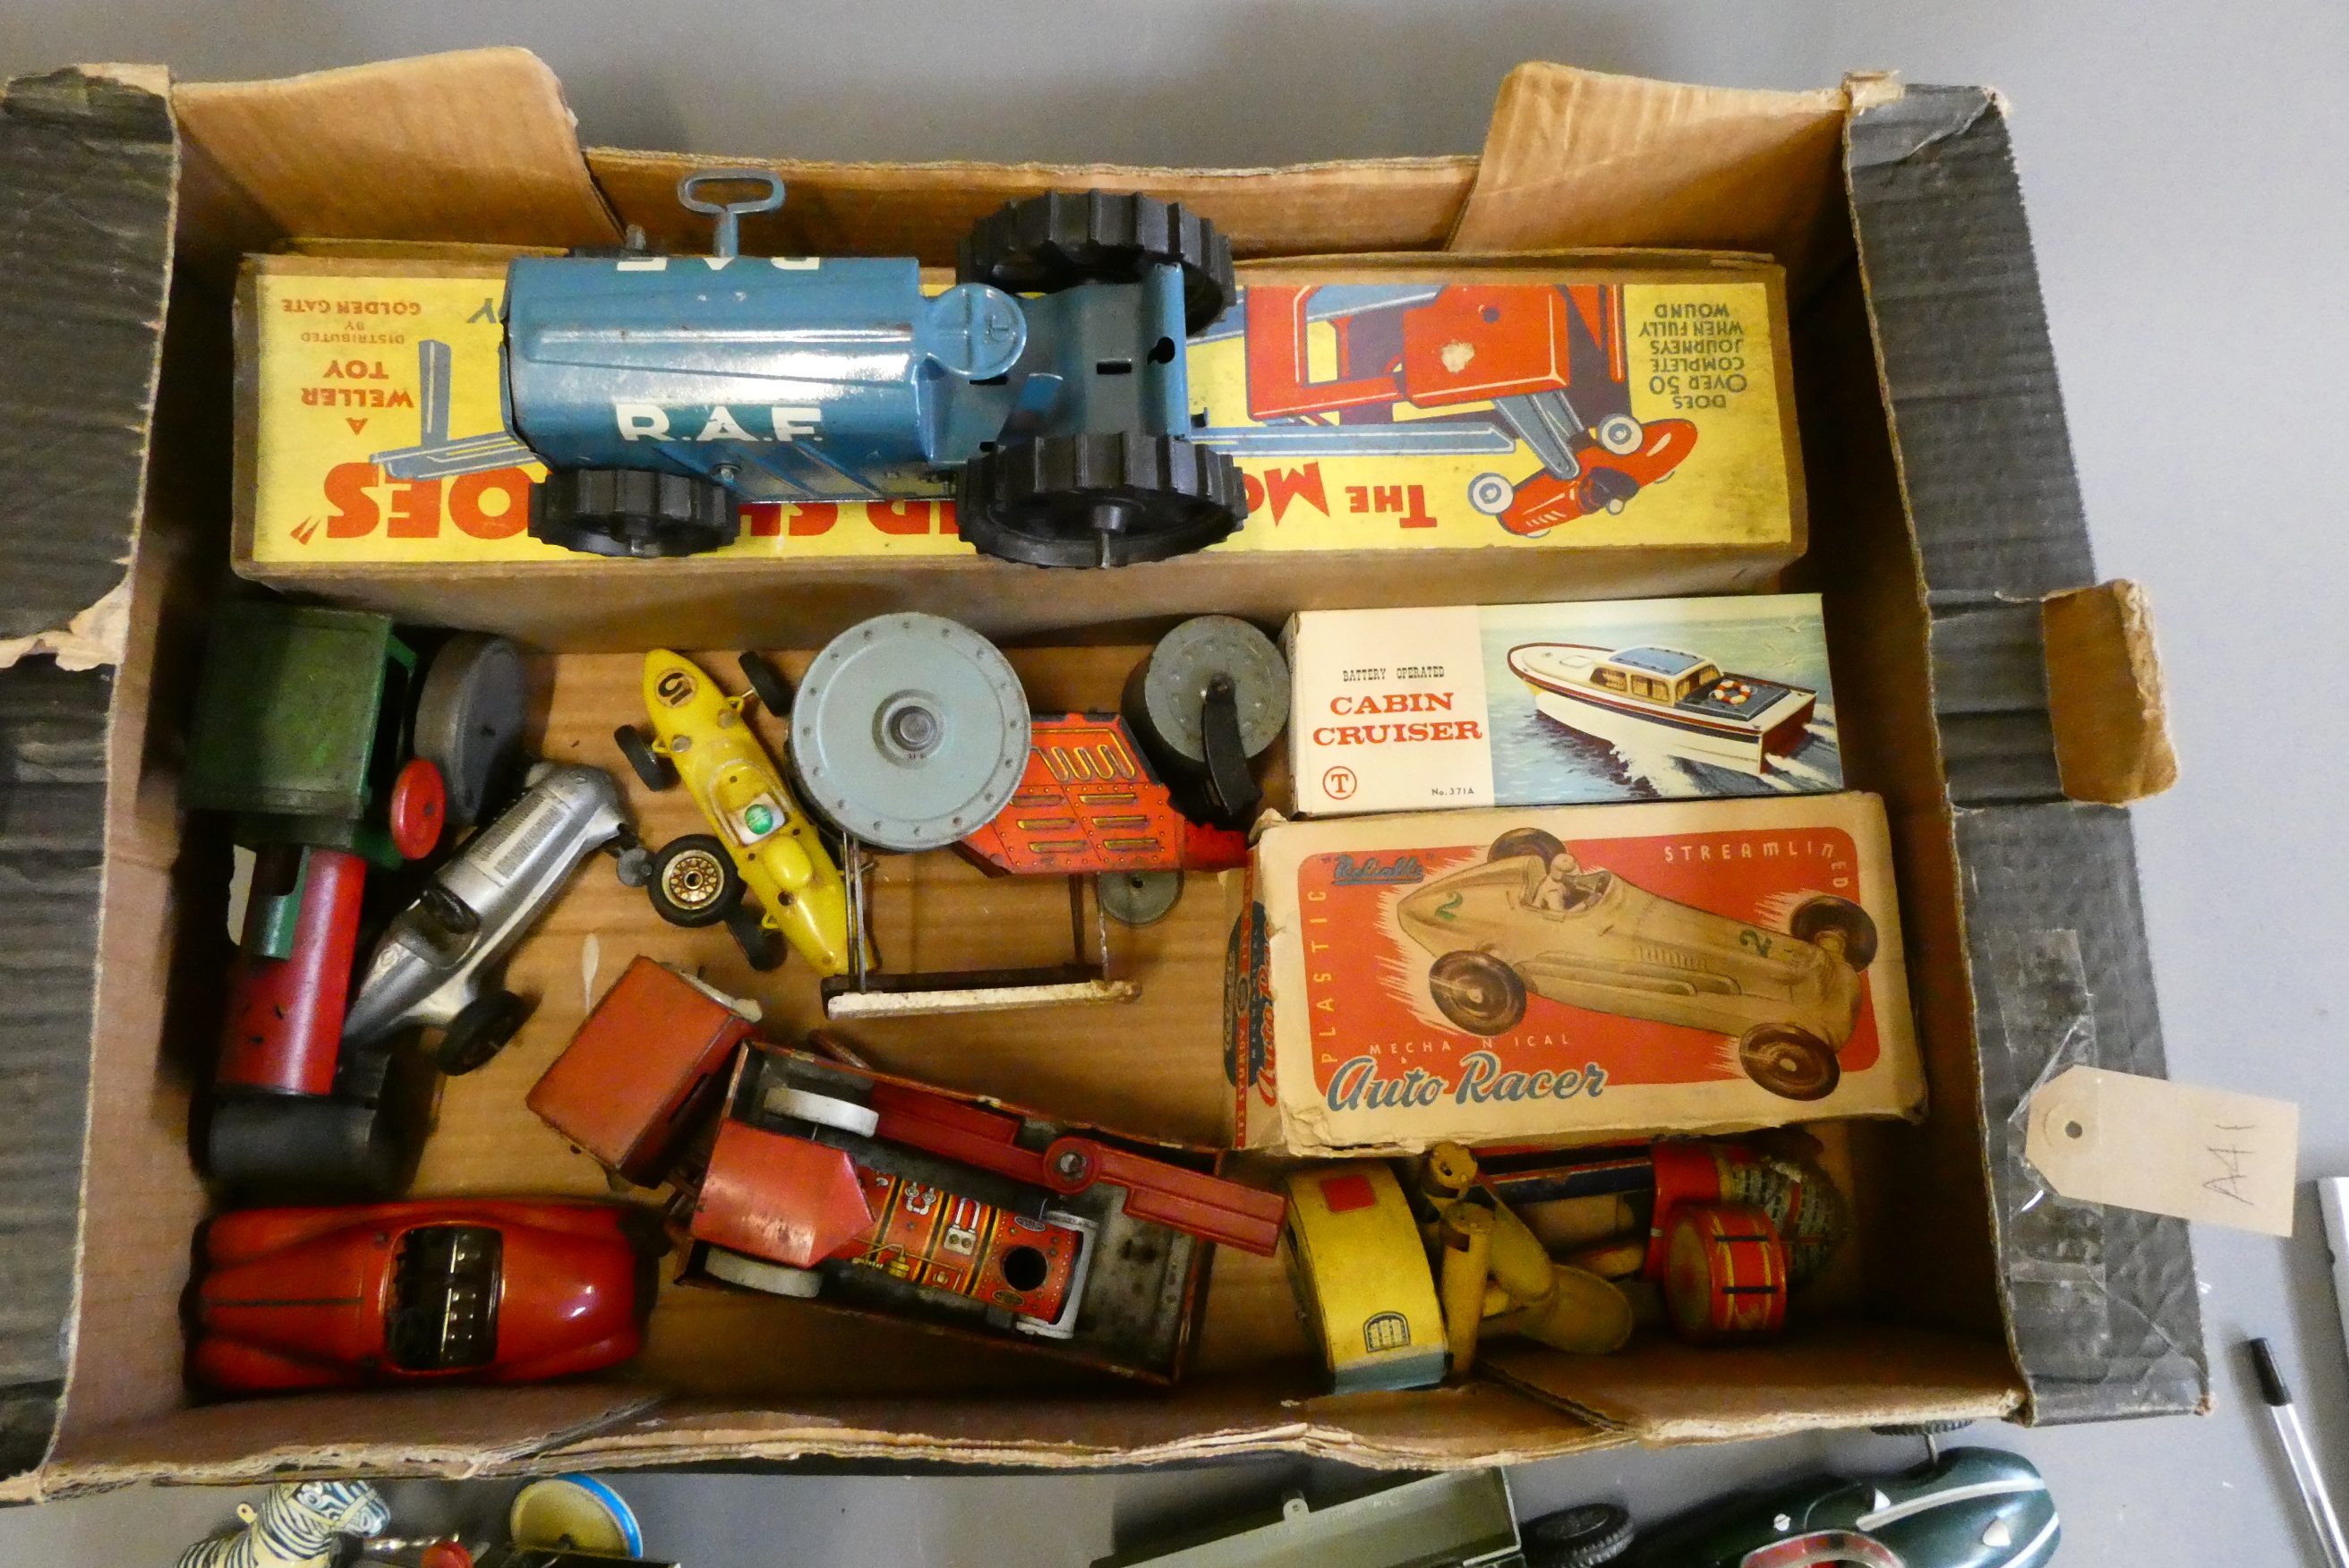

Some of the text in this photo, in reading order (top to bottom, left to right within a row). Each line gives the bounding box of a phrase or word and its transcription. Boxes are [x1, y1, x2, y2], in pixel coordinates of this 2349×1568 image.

[279, 297, 423, 316] GOLDEN GATE
[1653, 302, 1730, 319] WOUND
[344, 320, 365, 332] BY
[1638, 320, 1746, 338] WHEN FULLY
[300, 331, 406, 345] DISTRIBUTED
[1649, 338, 1745, 355] JOURNEYS
[322, 359, 389, 379] TOY
[1650, 355, 1746, 373] COMPLETE
[1649, 373, 1747, 396] OVER 50
[300, 386, 415, 409] WELLER
[1671, 393, 1727, 410] DOES
[346, 417, 369, 436] A
[615, 403, 824, 442] R.A.F.
[1345, 484, 1439, 529] THE
[1342, 665, 1446, 682] BATTERY OPERATED
[1329, 692, 1455, 716] CABIN
[1312, 720, 1483, 746] CRUISER
[1307, 890, 1339, 1065] PLASTIC
[1327, 1049, 1609, 1112] Auto Racer
